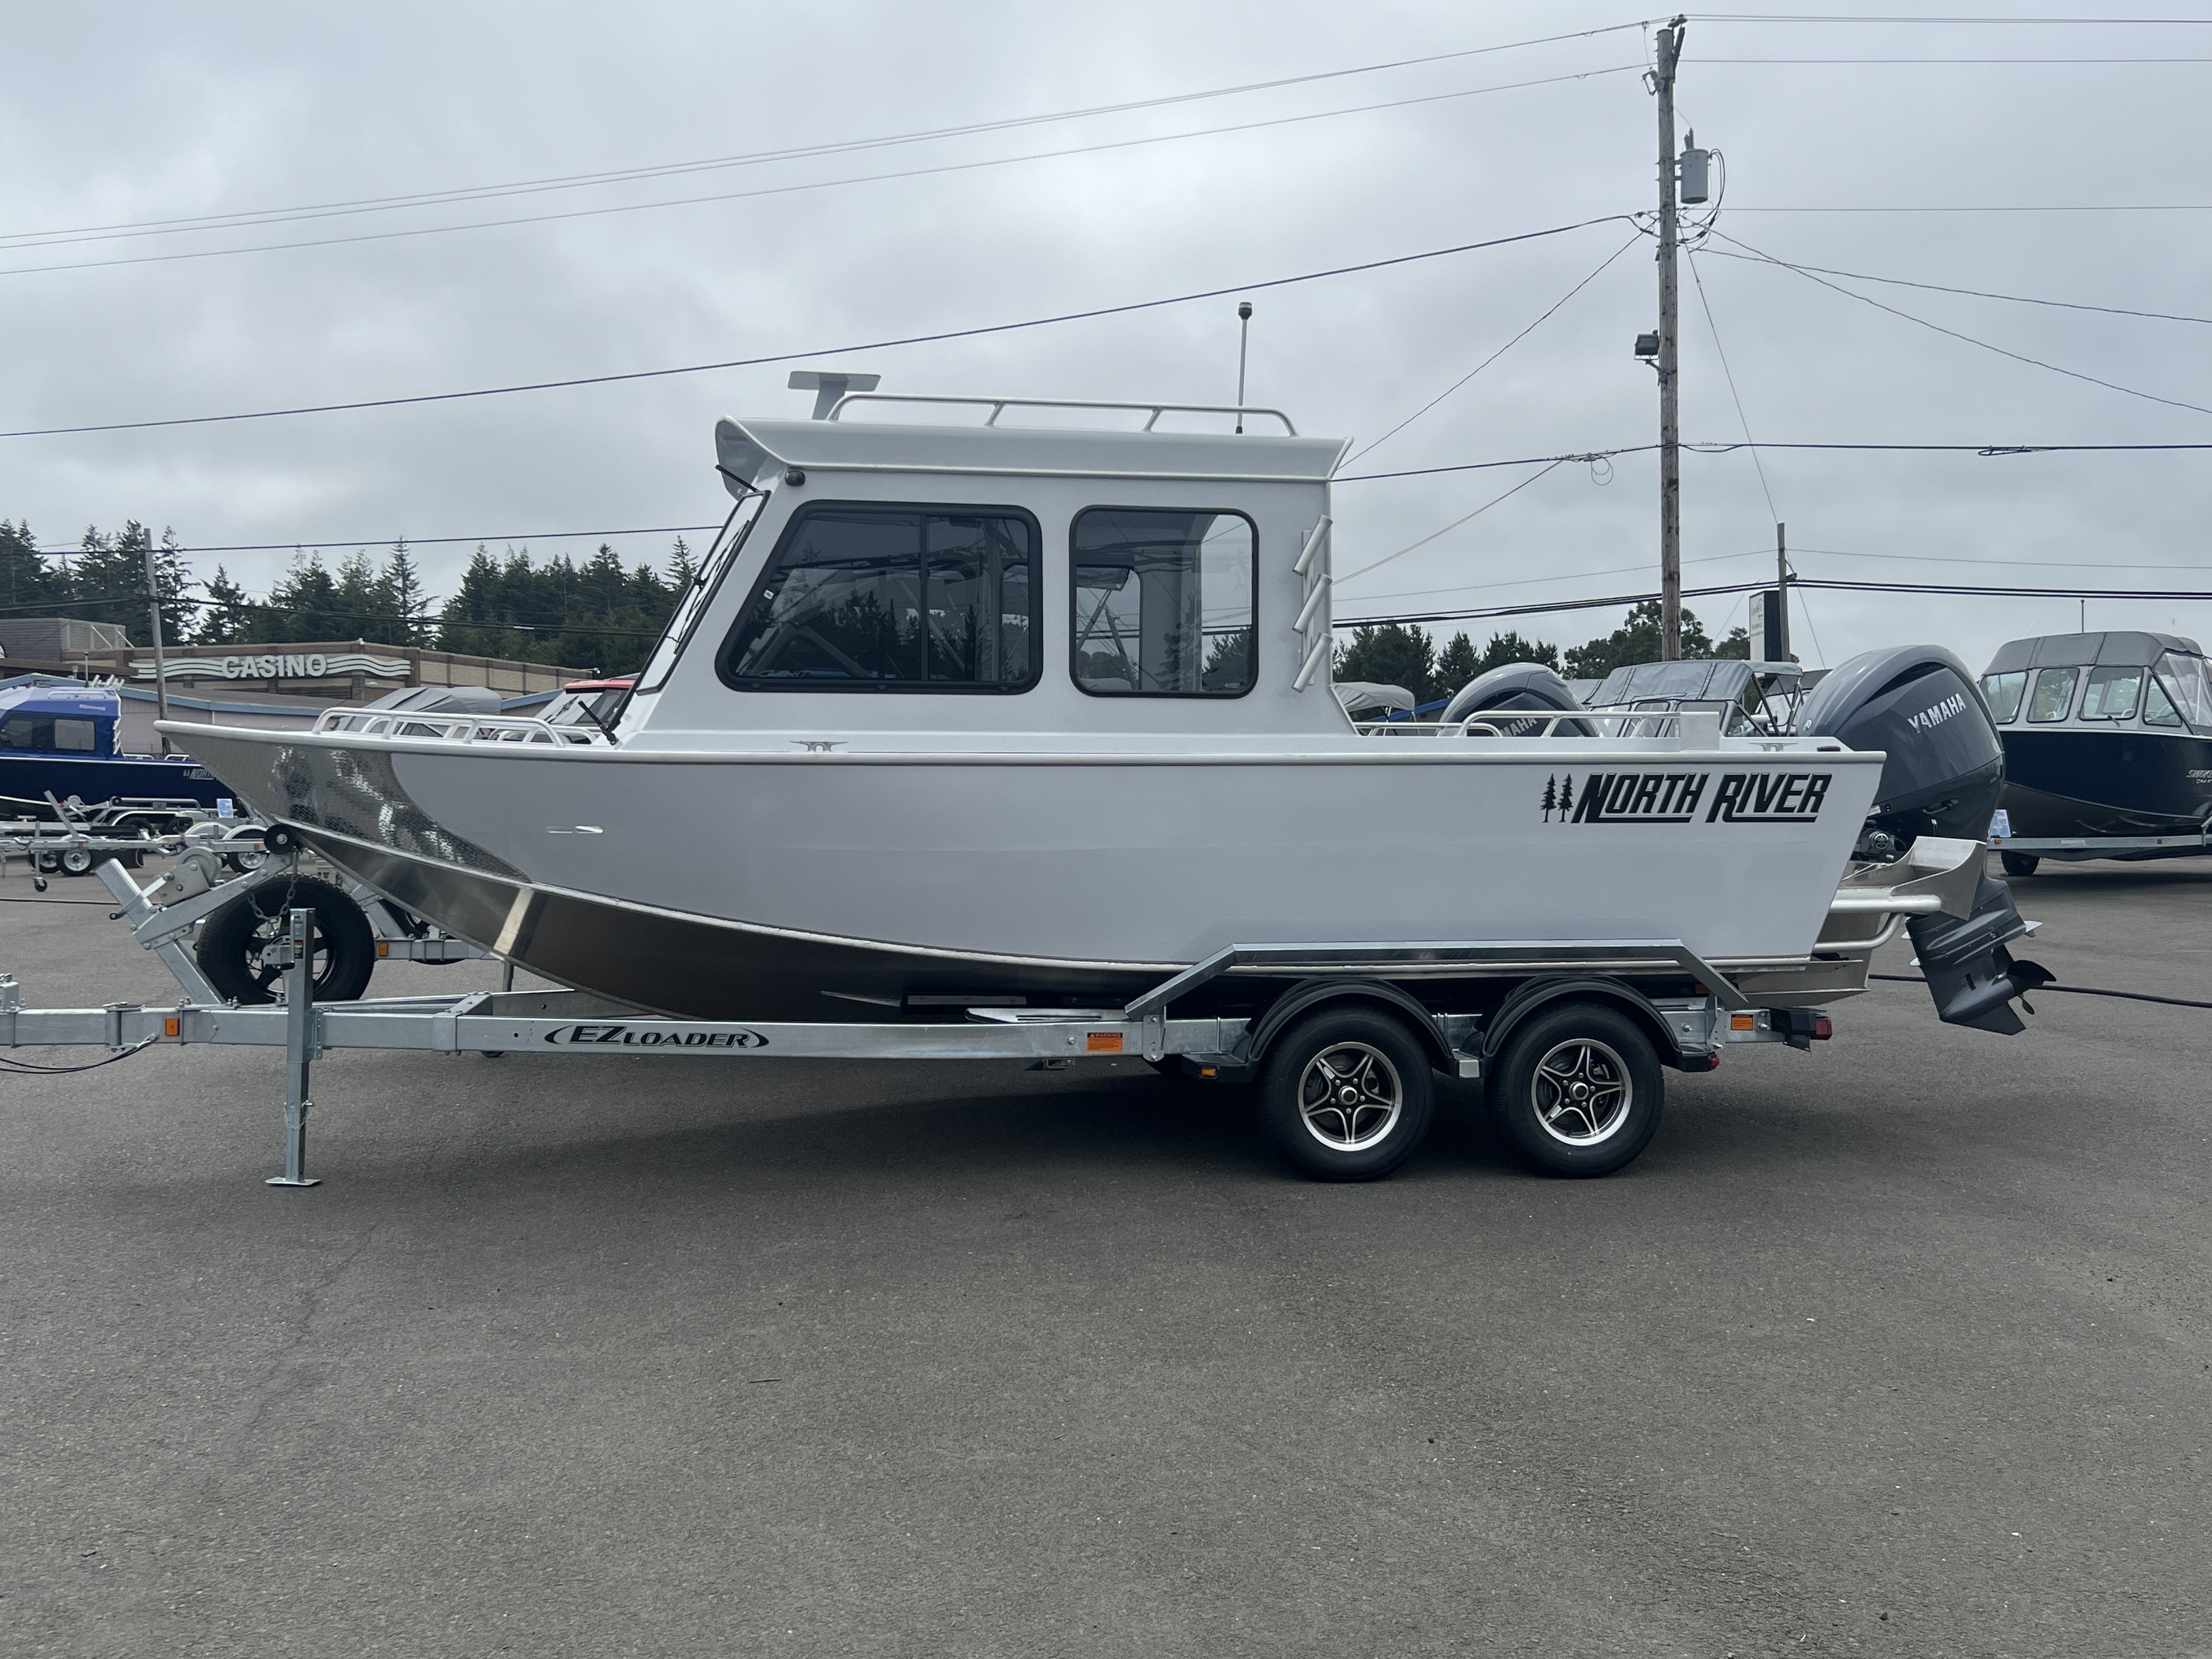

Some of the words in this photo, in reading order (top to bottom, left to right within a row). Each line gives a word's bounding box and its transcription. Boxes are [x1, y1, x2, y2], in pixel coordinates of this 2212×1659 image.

[222, 654, 327, 679] CASINO
[1499, 718, 1537, 736] MAHA
[1907, 693, 1966, 734] YAMAHA
[1571, 773, 1710, 823] NORTH
[1705, 773, 1832, 823] RIVER
